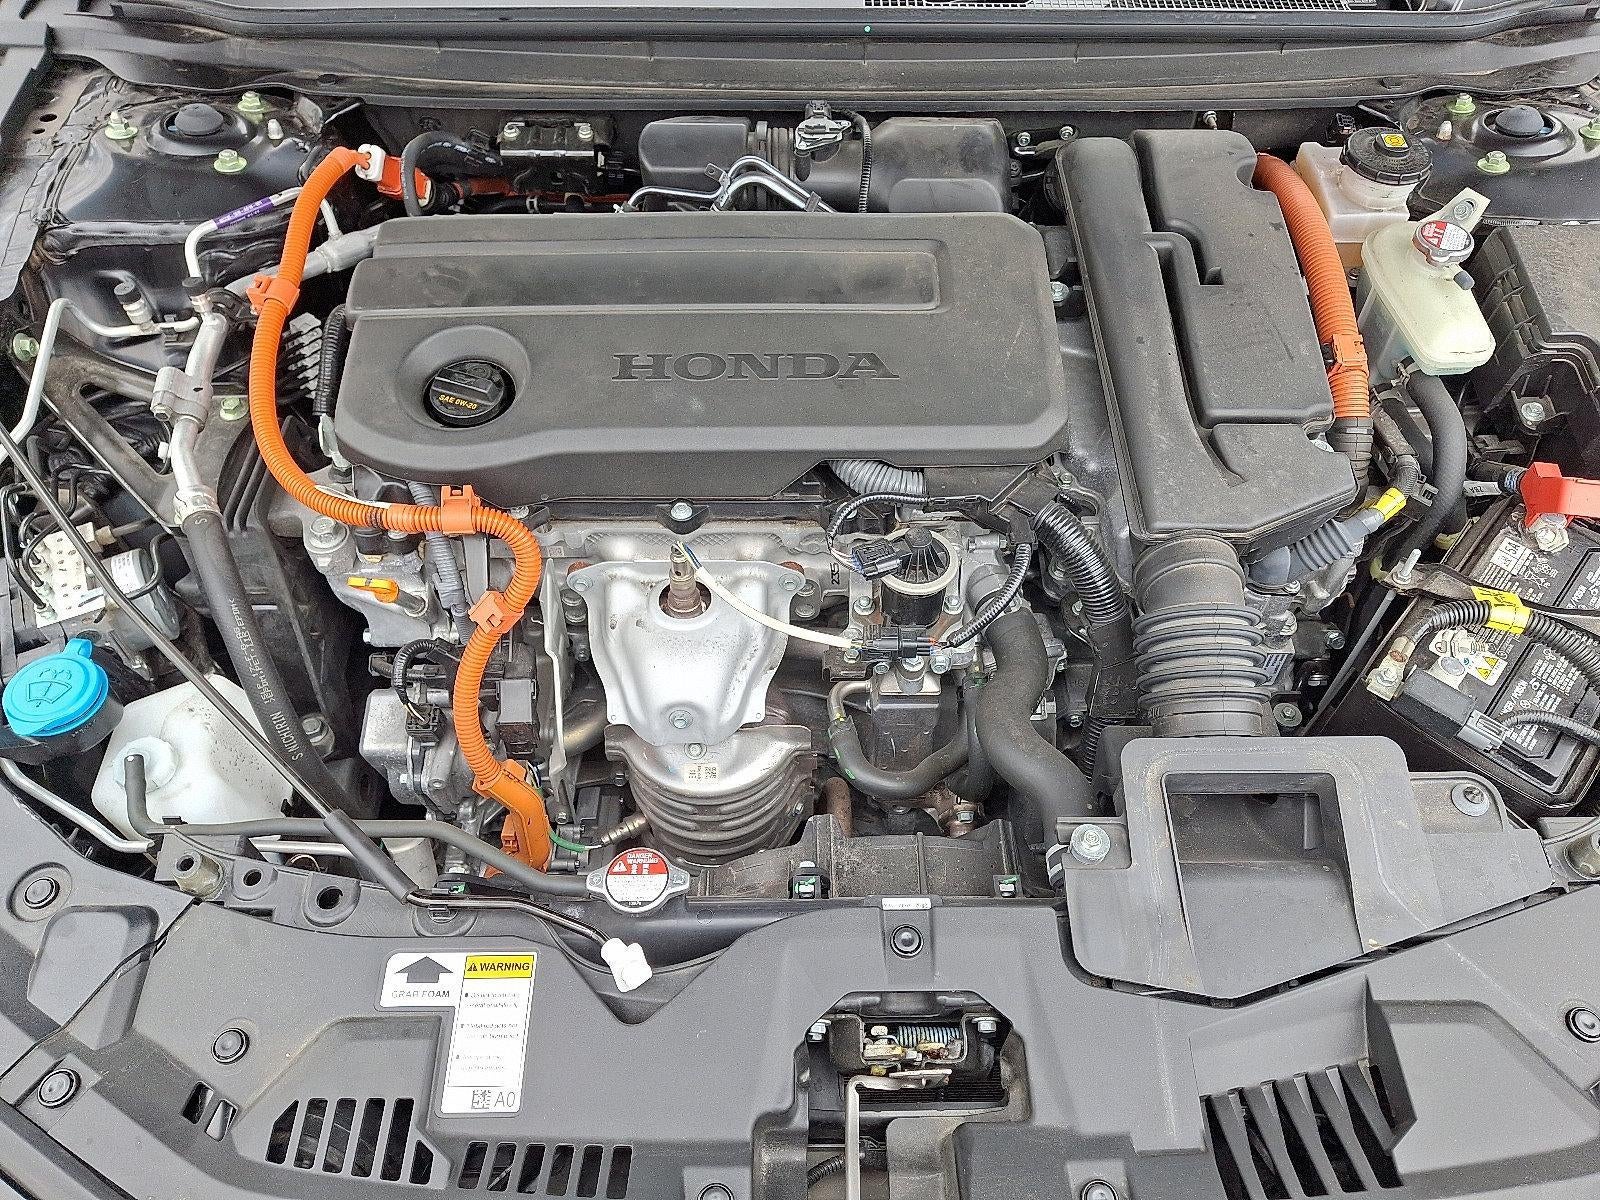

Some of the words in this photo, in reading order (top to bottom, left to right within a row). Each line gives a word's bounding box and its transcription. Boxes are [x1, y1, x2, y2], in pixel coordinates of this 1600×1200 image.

[611, 352, 900, 381] HONDA
[438, 394, 456, 404] SAE
[455, 399, 478, 411] 0W-20
[479, 962, 531, 972] WARNING
[422, 990, 450, 998] FOAM
[494, 1091, 516, 1108] A0
